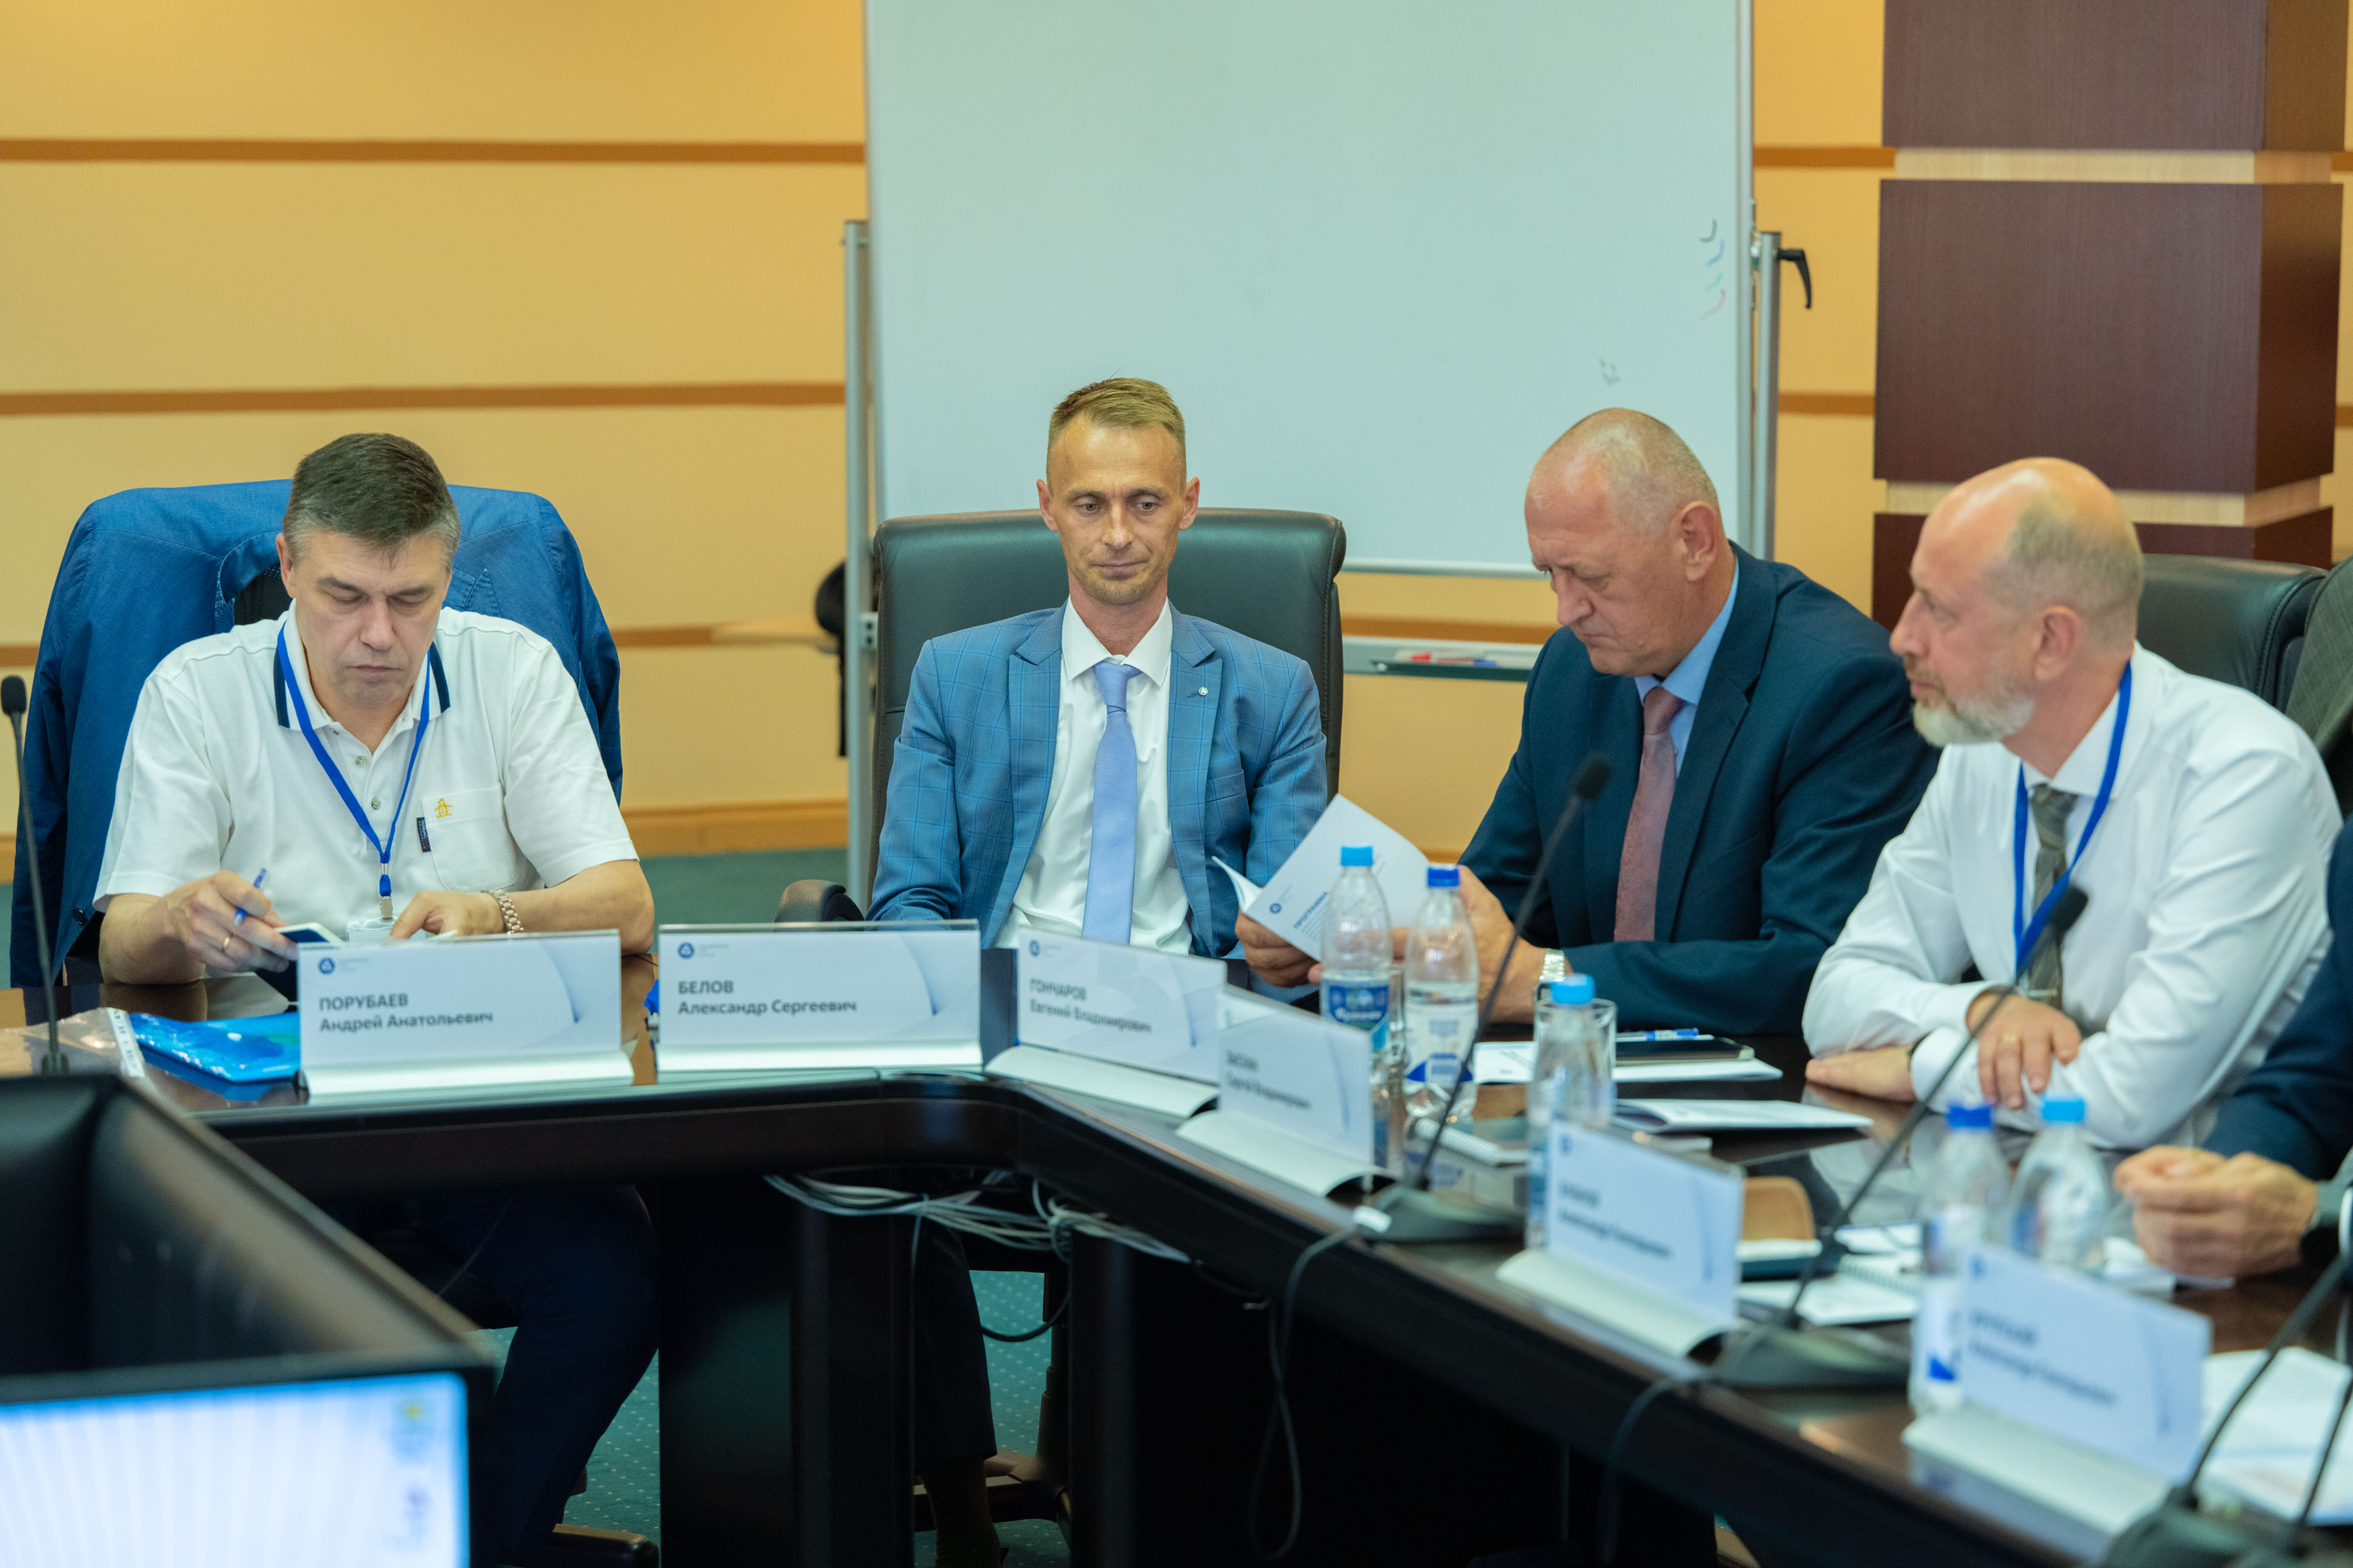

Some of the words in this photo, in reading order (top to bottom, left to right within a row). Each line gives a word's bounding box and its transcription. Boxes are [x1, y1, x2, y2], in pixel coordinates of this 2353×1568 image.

[678, 980, 734, 995] БЕЛОВ
[1029, 978, 1087, 1001] ГОНЧАРОВ
[319, 993, 408, 1011] ПОРУБАЕВ
[678, 1001, 768, 1016] Александр
[771, 999, 857, 1015] Сергеевич
[1029, 998, 1071, 1018] Евгений
[320, 1015, 383, 1033] Андрей
[386, 1012, 493, 1028] Анатольевич
